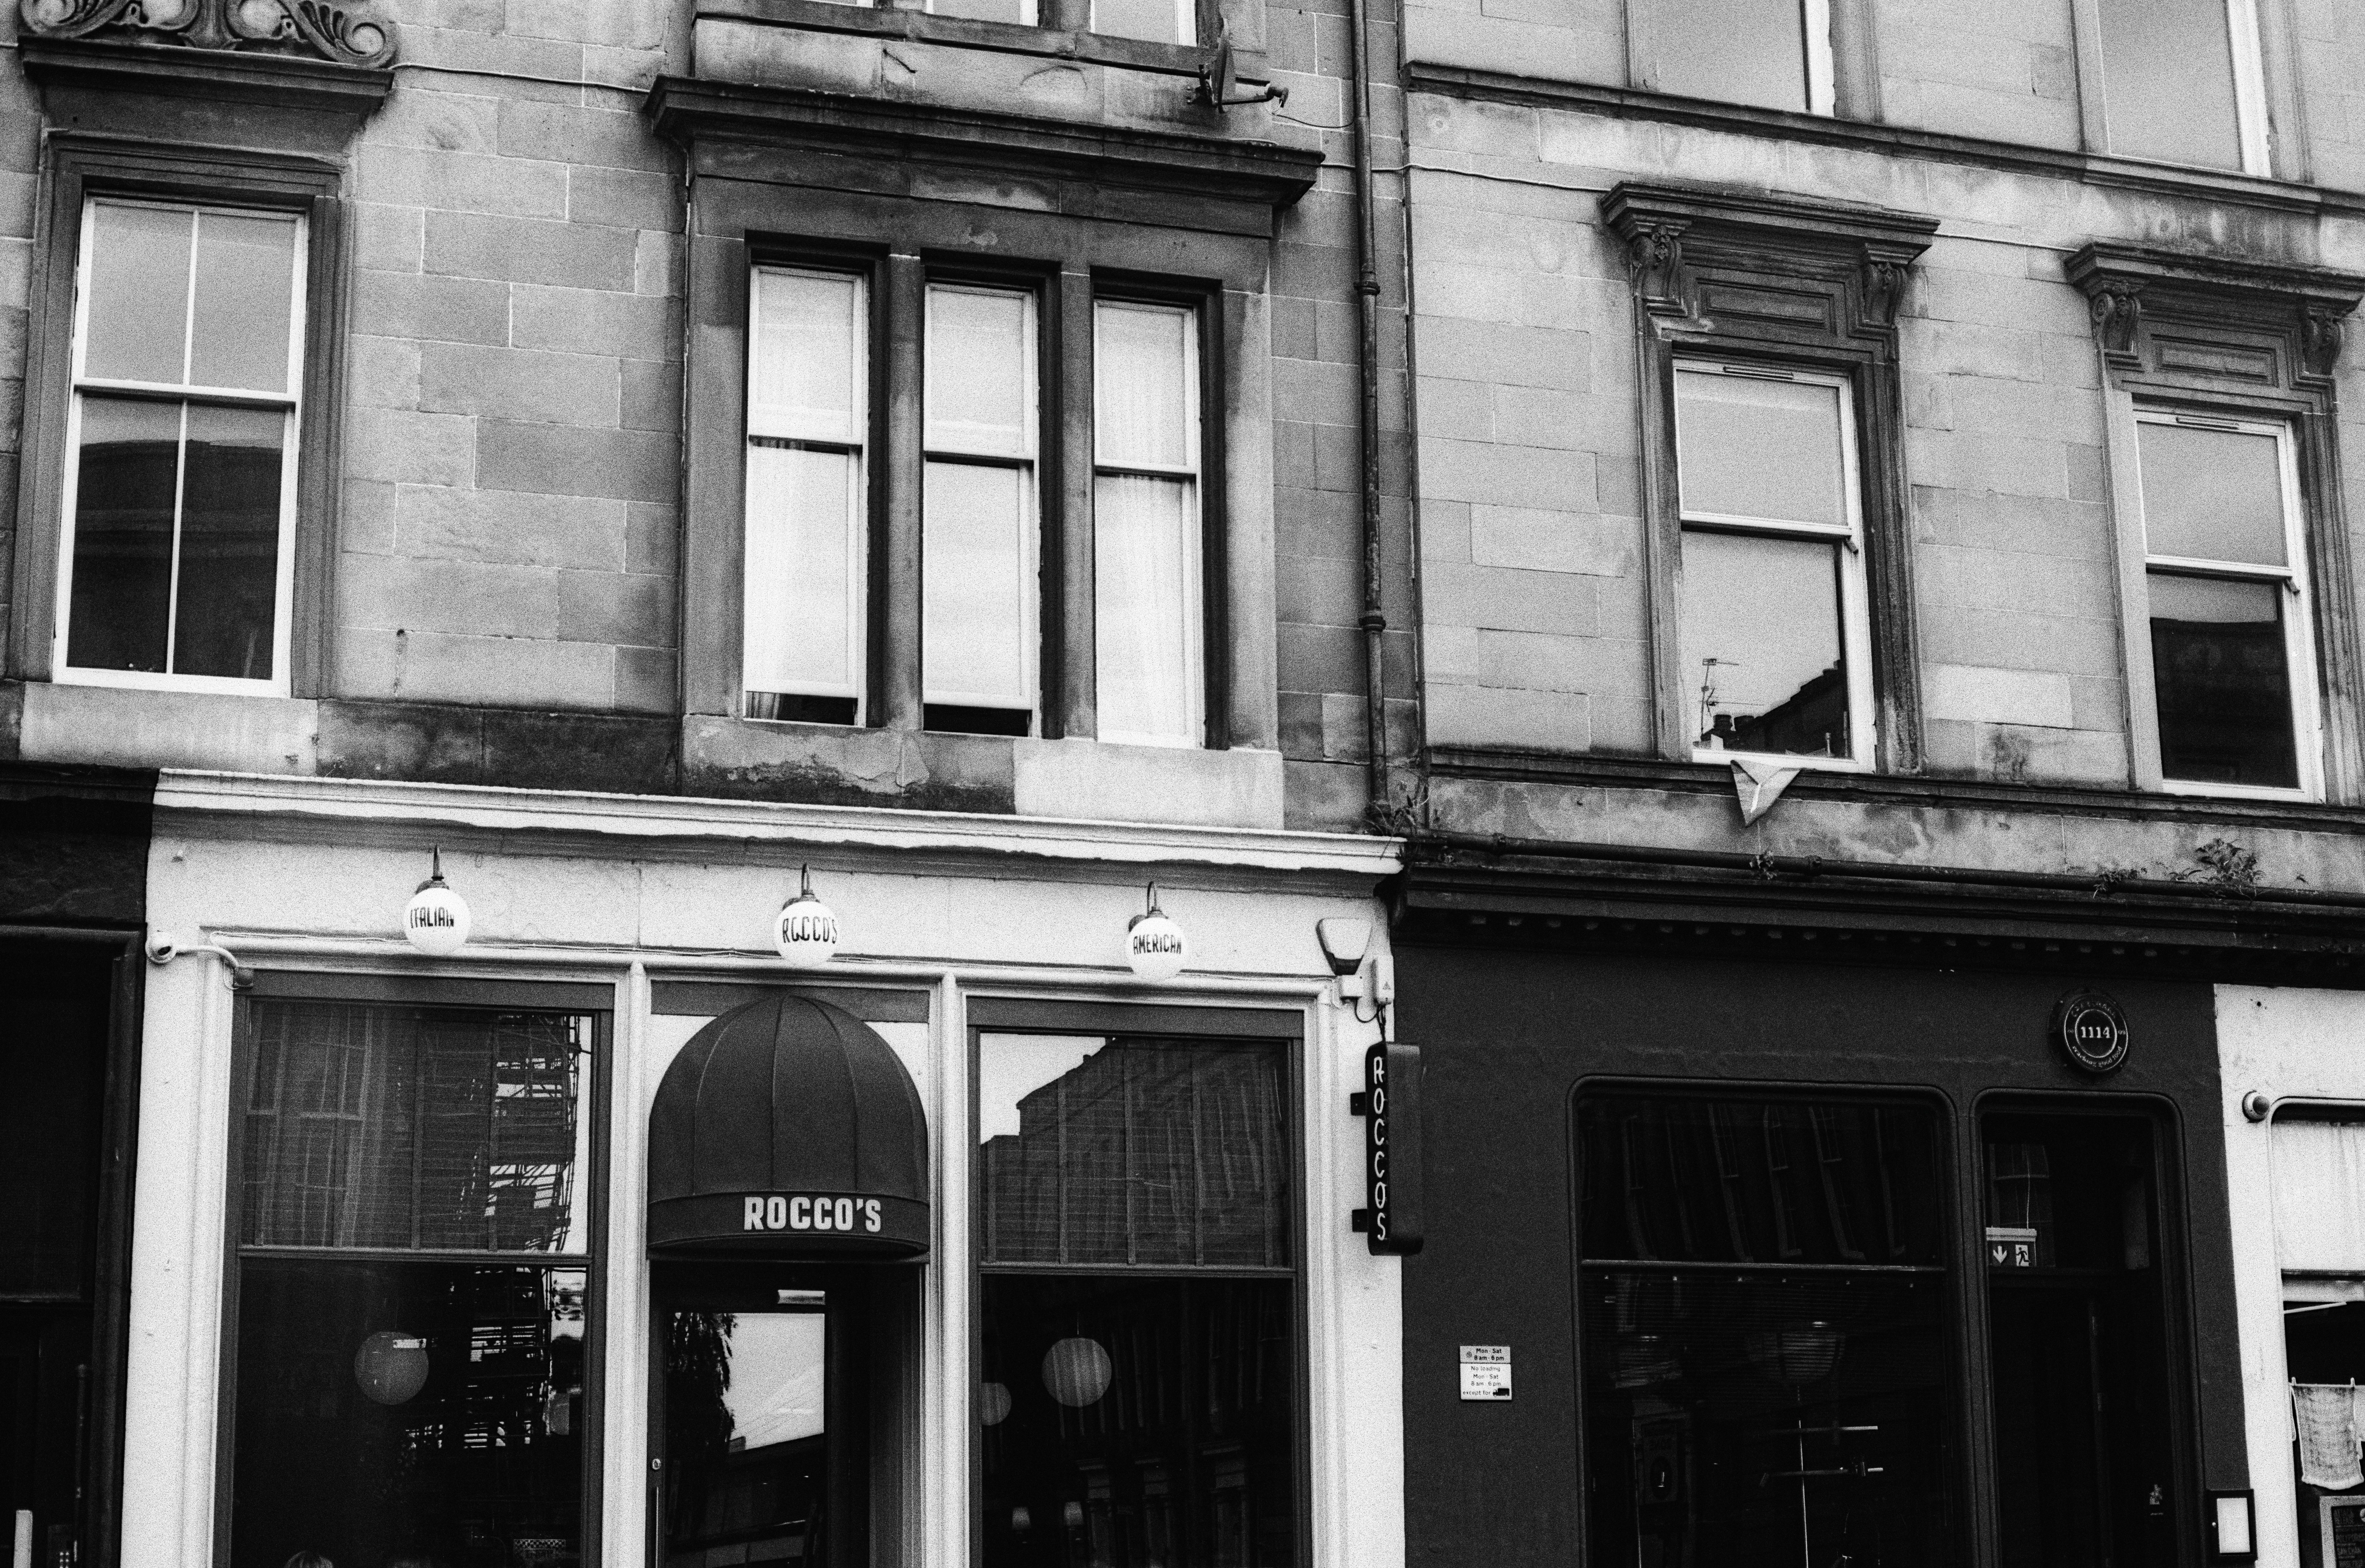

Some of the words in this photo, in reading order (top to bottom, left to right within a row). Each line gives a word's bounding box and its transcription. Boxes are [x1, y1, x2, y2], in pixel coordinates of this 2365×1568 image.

[410, 907, 454, 929] ITALIAN
[1133, 933, 1181, 955] AMERICAN
[2081, 1026, 2110, 1038] 1114
[744, 1197, 881, 1232] ROCCO'S
